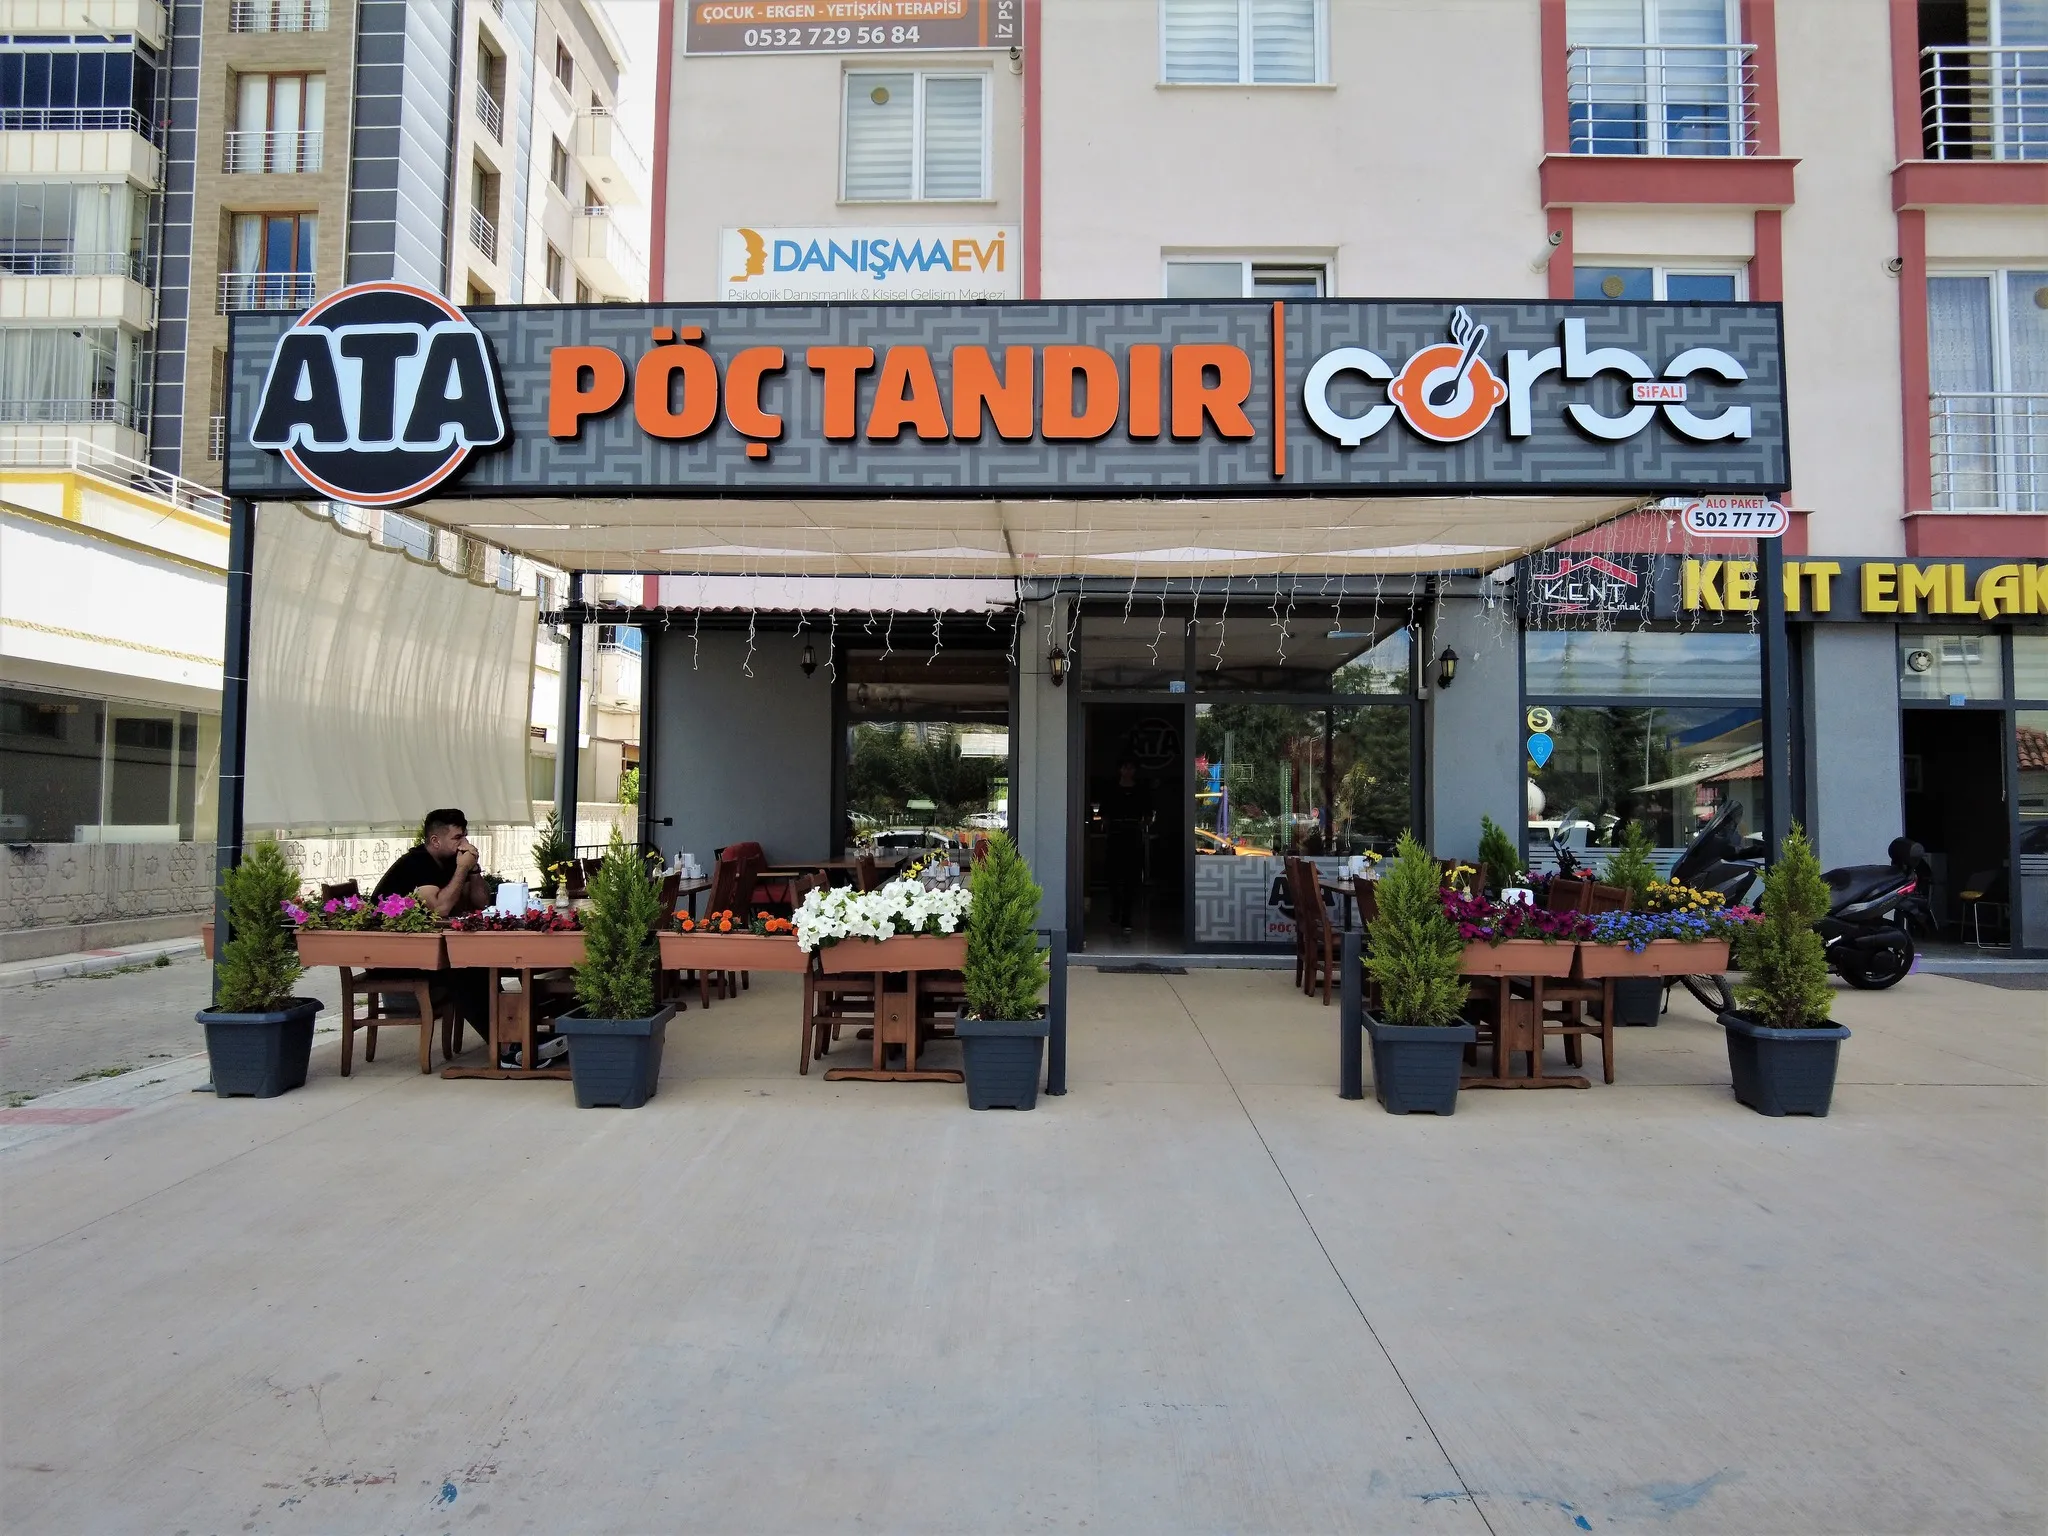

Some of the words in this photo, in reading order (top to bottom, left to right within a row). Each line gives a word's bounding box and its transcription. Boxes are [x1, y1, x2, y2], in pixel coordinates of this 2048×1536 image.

[703, 6, 754, 23] ÇOCUK
[766, 5, 815, 18] ERGEN
[827, 1, 893, 20] YETİŞKİN
[896, 0, 961, 15] TERAPİSİ
[744, 28, 801, 47] 0532
[808, 27, 850, 45] 729
[857, 26, 886, 44] 56
[891, 25, 920, 44] 84
[995, 23, 1013, 39] İZ
[773, 231, 1005, 281] DANIŞMAEVİ
[728, 288, 781, 300] Psikolojik
[860, 288, 870, 300] &
[960, 288, 1006, 300] Merkezi
[251, 330, 504, 446] ATA
[549, 326, 785, 457] PÖÇ
[805, 344, 1256, 439] TANDIR
[1706, 499, 1727, 508] ALO
[1731, 498, 1765, 508] PAKET
[1695, 512, 1728, 527] 502
[1733, 512, 1752, 527] 77
[1757, 513, 1777, 528] 77
[1545, 580, 1625, 602] KENT
